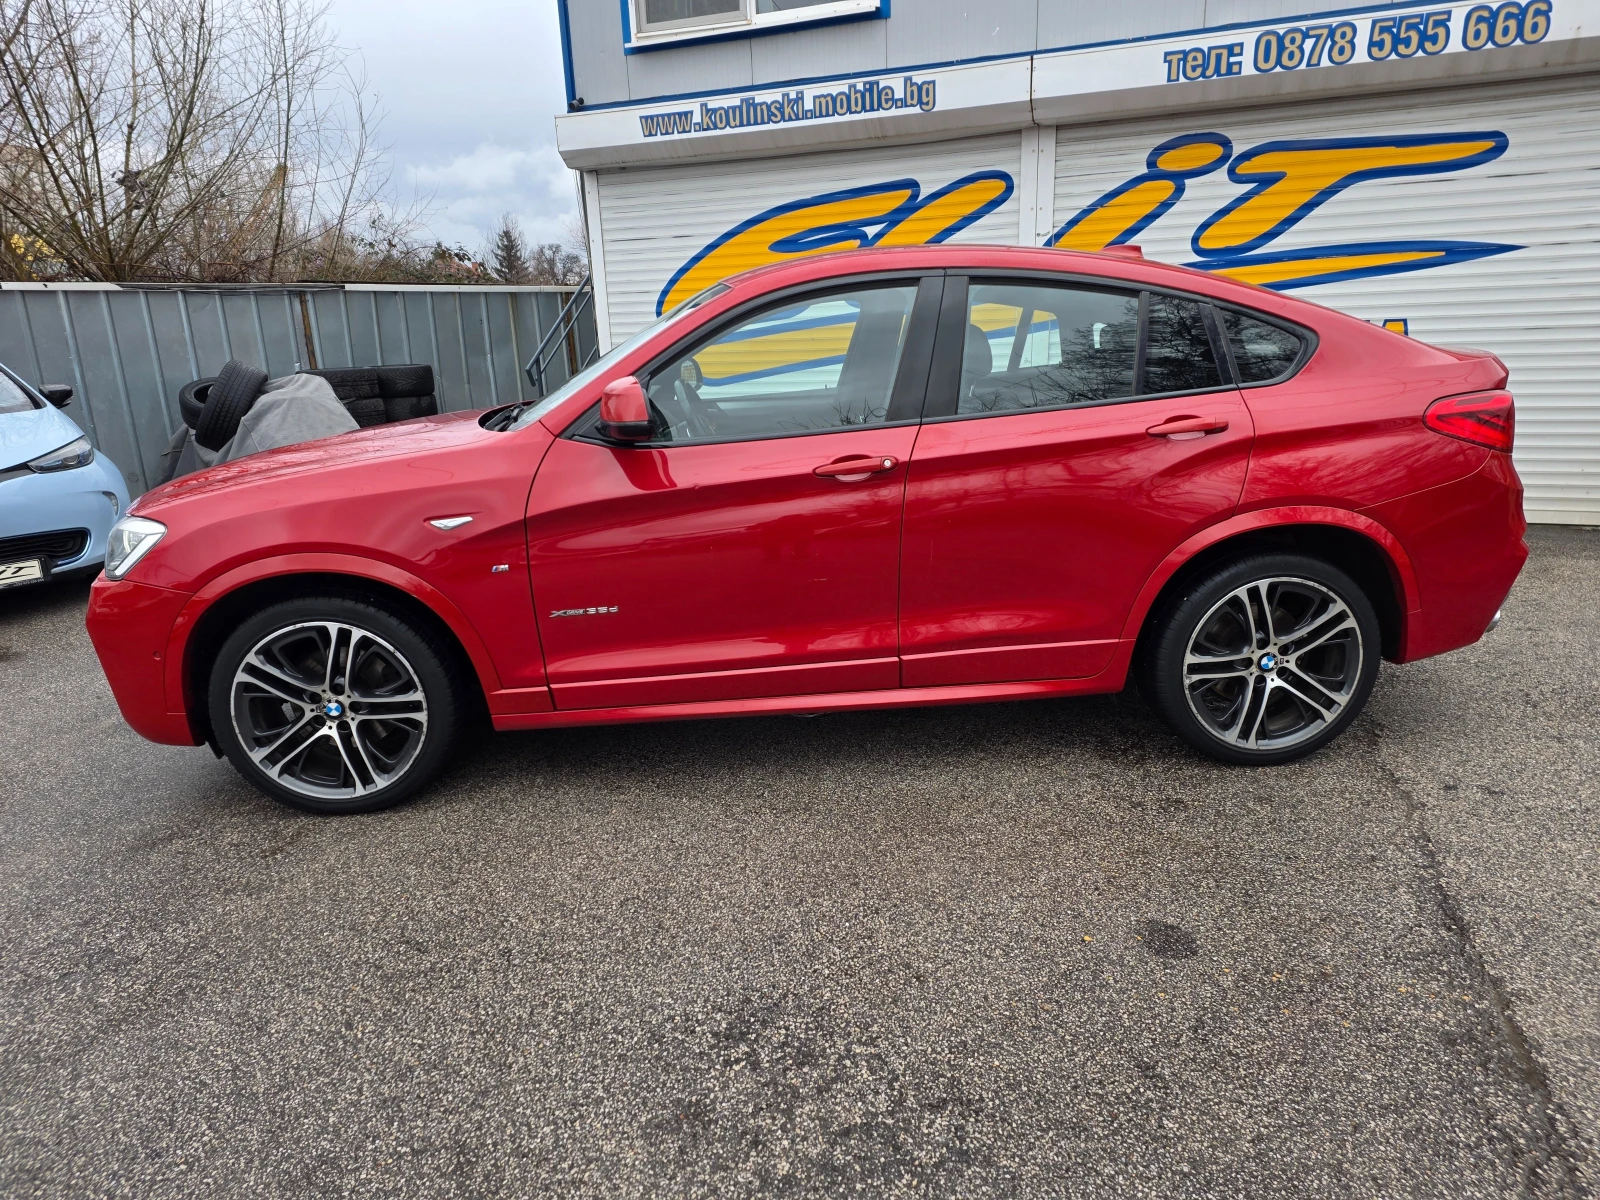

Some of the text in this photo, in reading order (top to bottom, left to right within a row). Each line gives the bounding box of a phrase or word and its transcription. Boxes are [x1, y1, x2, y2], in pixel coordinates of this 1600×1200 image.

[1164, 0, 1553, 82] тел: 0878 555 666
[639, 77, 936, 137] www.koulinski.mobile.bg
